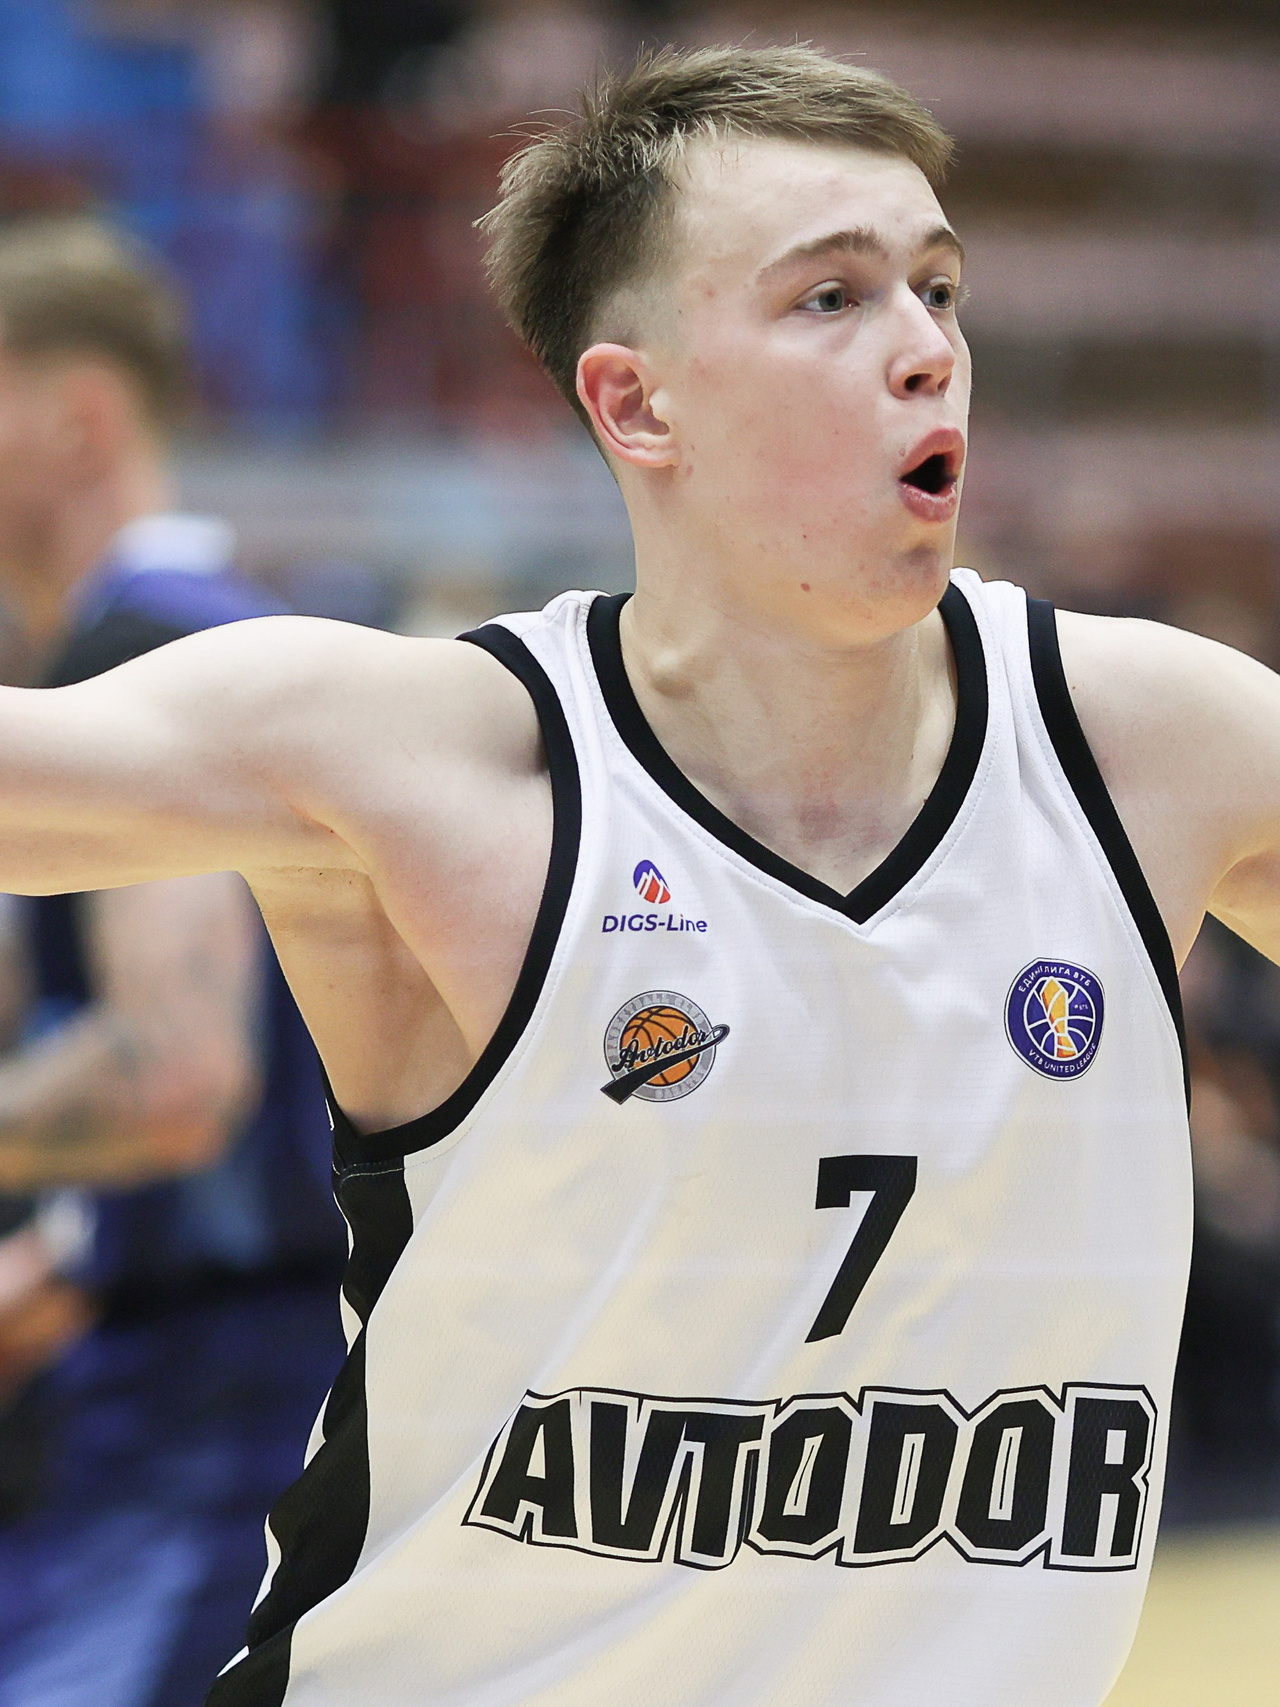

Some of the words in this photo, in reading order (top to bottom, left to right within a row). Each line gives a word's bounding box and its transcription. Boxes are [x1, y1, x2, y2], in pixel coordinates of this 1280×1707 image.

[601, 913, 708, 933] DIGS-Line
[1044, 966, 1071, 976] ЛИГА
[1072, 971, 1092, 987] ВТБ
[611, 1024, 708, 1072] Avtodor
[1028, 1049, 1043, 1065] VTB
[1044, 1061, 1076, 1073] UNITED
[1076, 1043, 1097, 1070] LEAGUE
[804, 1155, 918, 1344] 7
[461, 1381, 1159, 1572] AVTODOR
